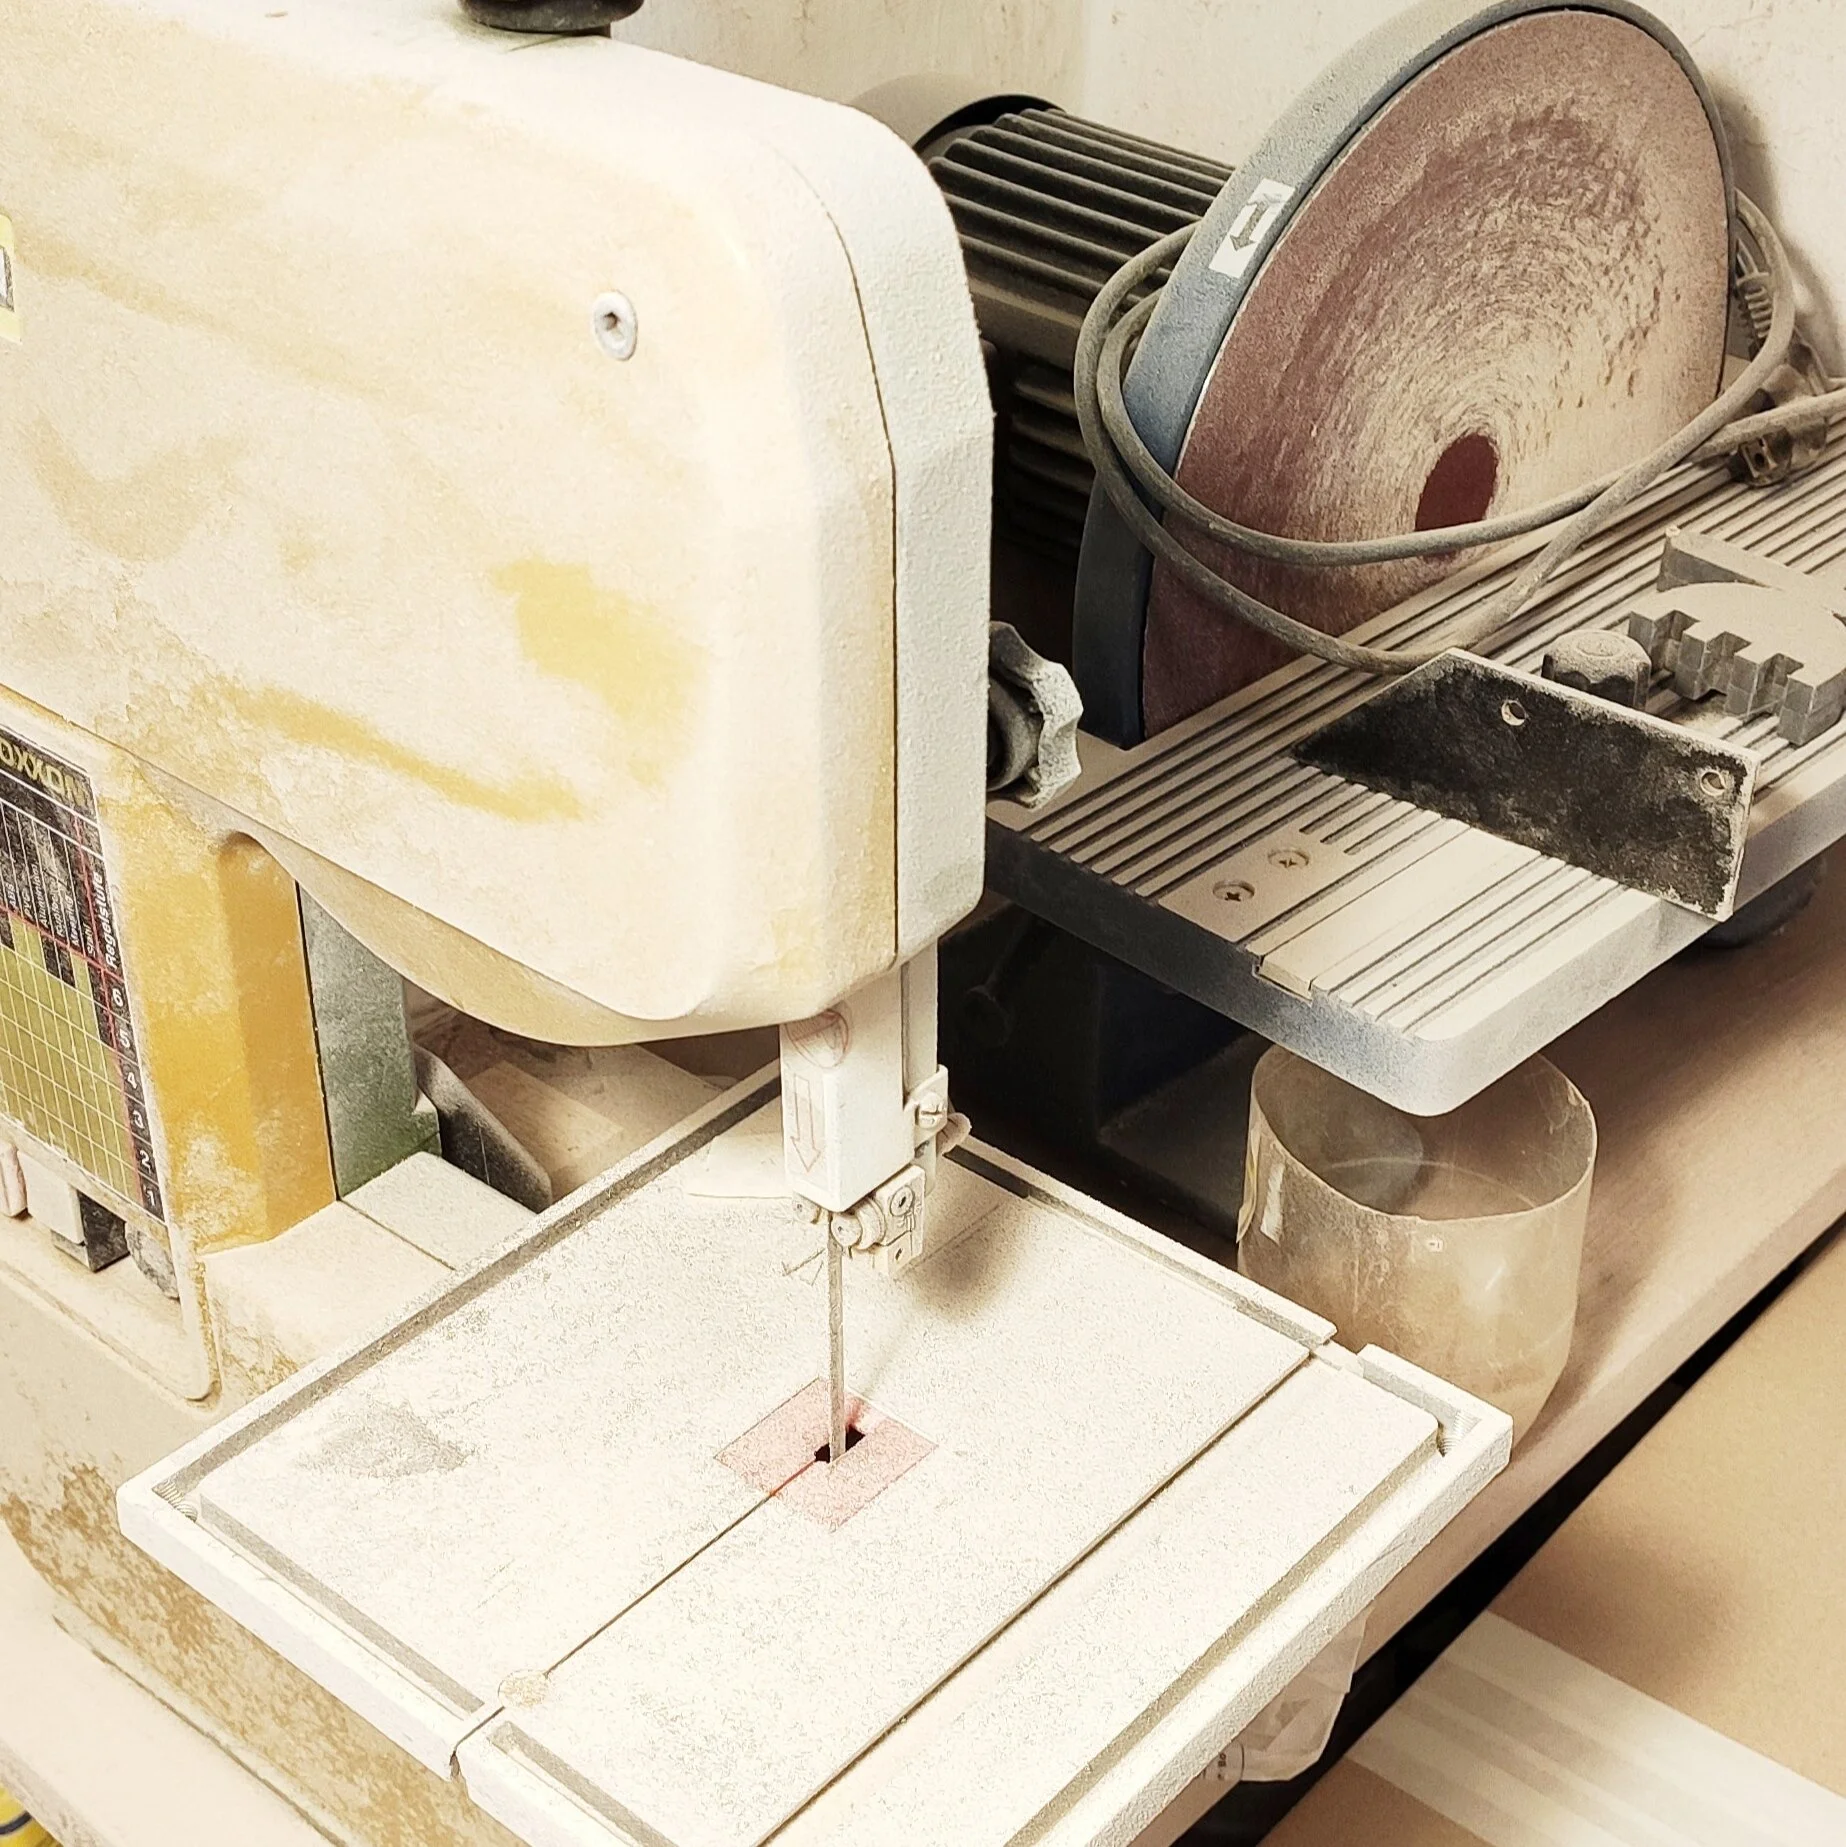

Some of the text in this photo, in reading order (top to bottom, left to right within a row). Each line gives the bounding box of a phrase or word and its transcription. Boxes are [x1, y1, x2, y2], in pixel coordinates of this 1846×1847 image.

[92, 871, 117, 969] Regelstufe
[83, 922, 95, 957] Stahl
[112, 989, 124, 1008] 6
[119, 1029, 131, 1048] 5
[127, 1071, 138, 1089] 4
[132, 1110, 144, 1129] 3
[139, 1150, 152, 1172] 2
[146, 1188, 155, 1207] 1
